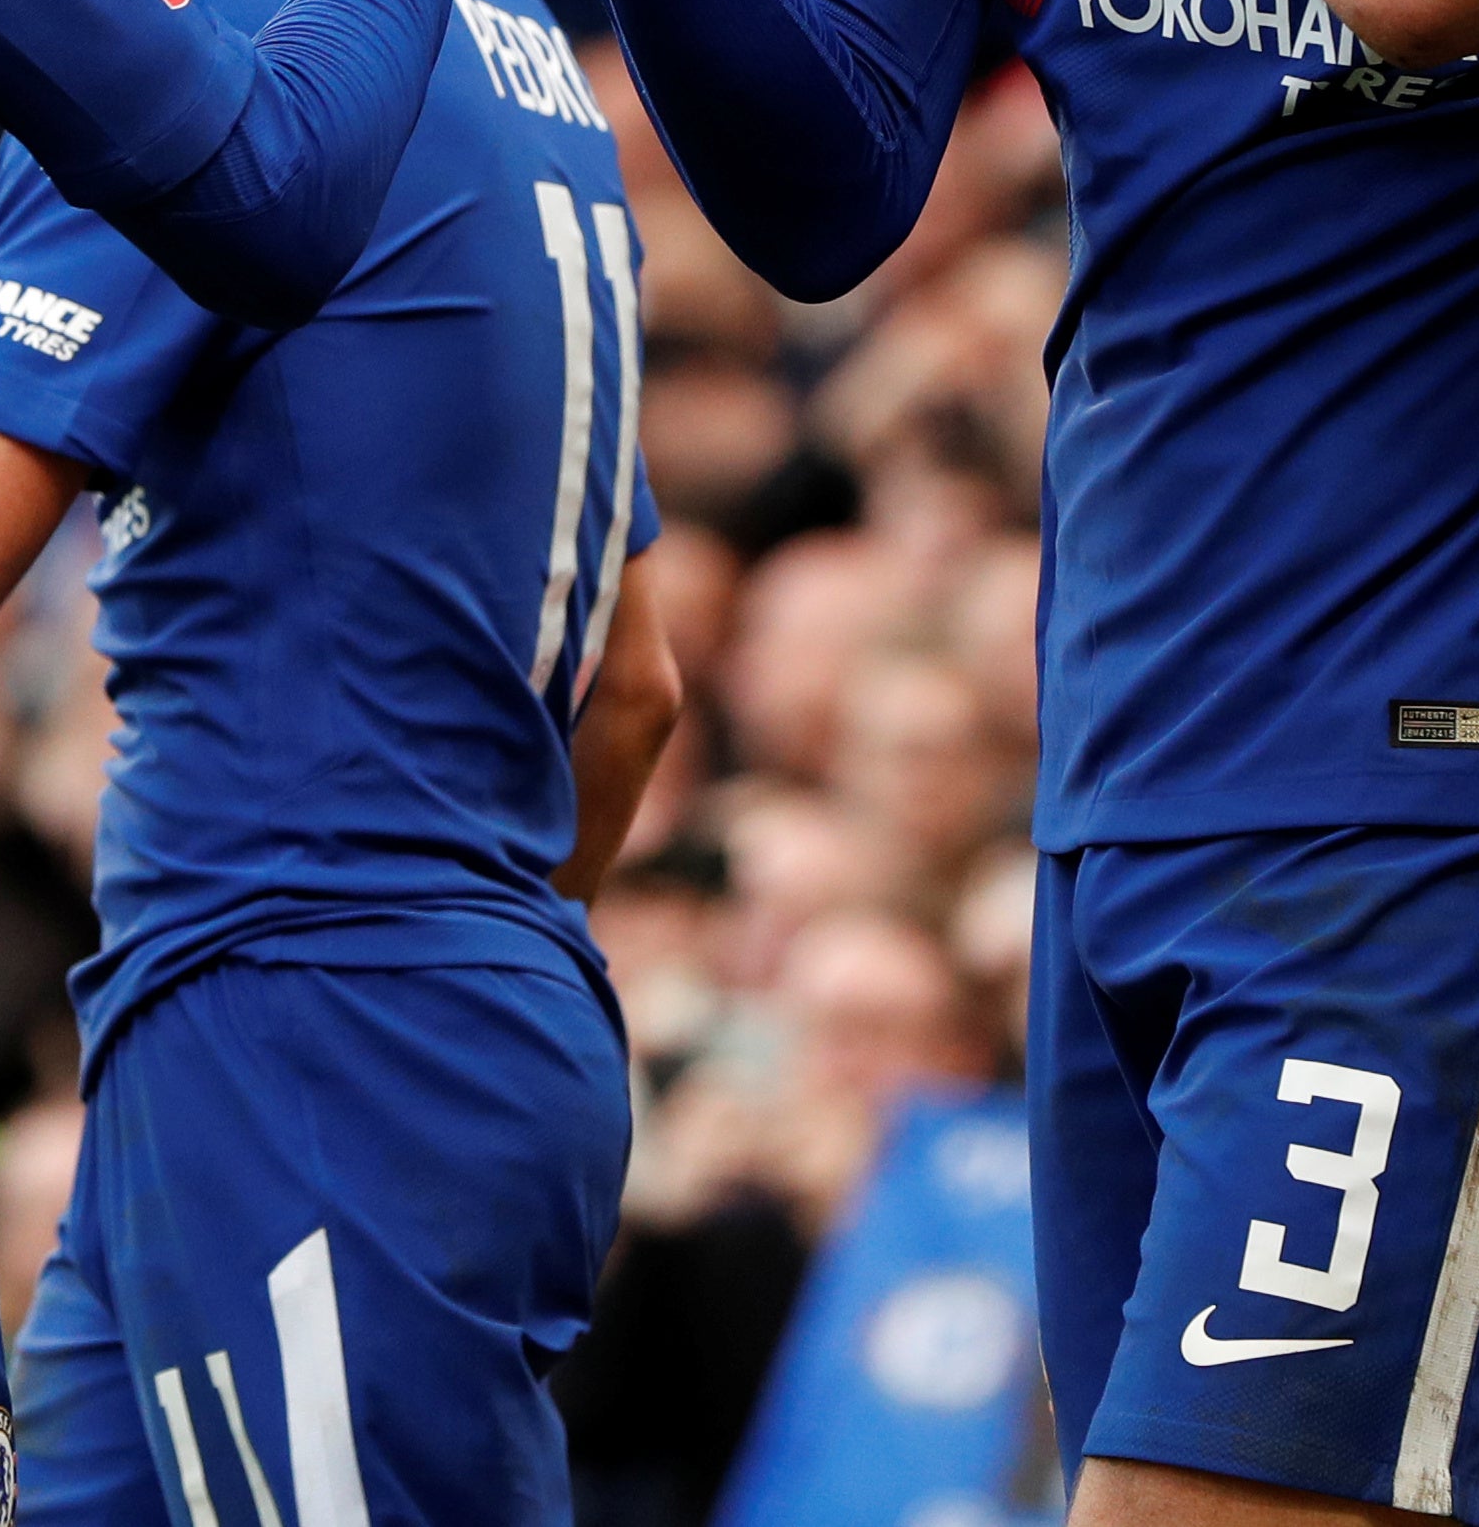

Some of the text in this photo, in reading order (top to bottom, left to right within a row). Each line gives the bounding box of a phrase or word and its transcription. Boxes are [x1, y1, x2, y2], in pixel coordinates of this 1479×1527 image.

[1280, 67, 1475, 116] TRE
[534, 181, 640, 728] 11
[1238, 1058, 1402, 1312] 3
